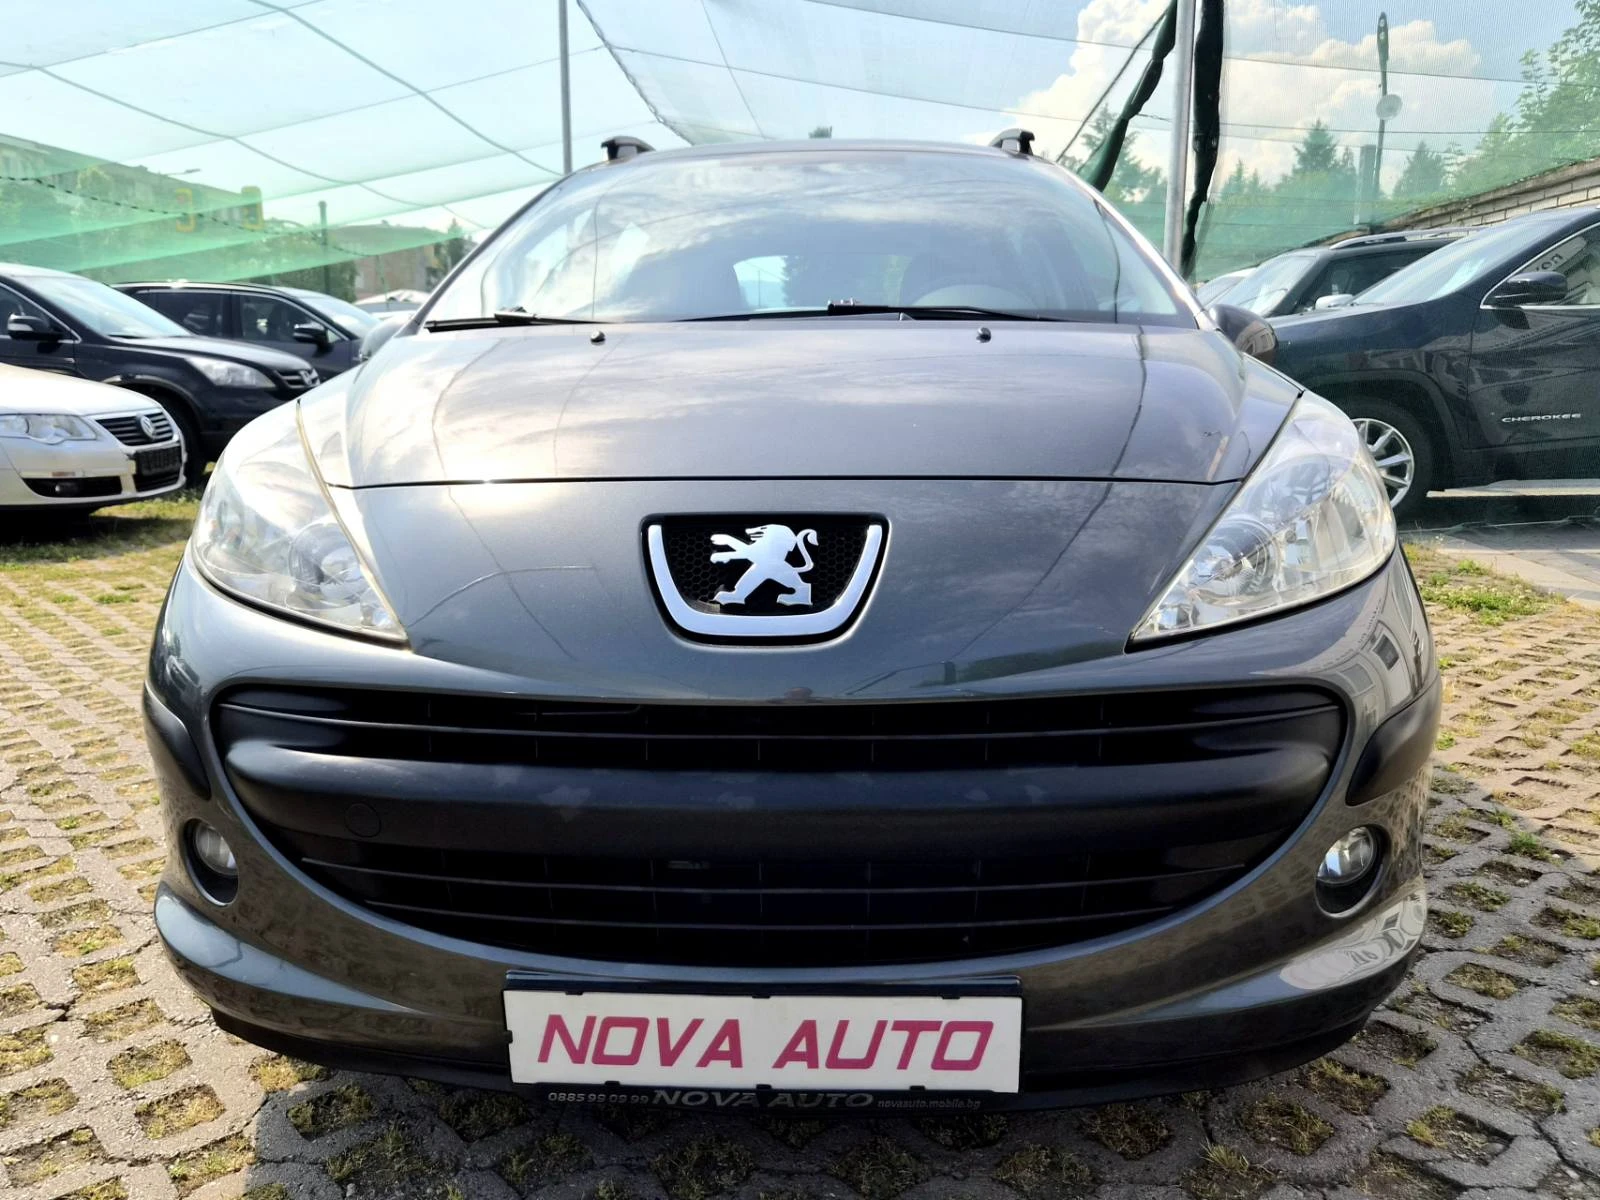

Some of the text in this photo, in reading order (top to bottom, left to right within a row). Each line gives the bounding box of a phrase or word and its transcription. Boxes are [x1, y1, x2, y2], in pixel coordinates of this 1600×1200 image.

[1501, 413, 1581, 423] CHEROKEE
[538, 1015, 994, 1072] NOVA AUTO
[549, 1091, 586, 1102] 0885
[651, 1089, 760, 1108] NOVA
[767, 1092, 874, 1108] AUTO
